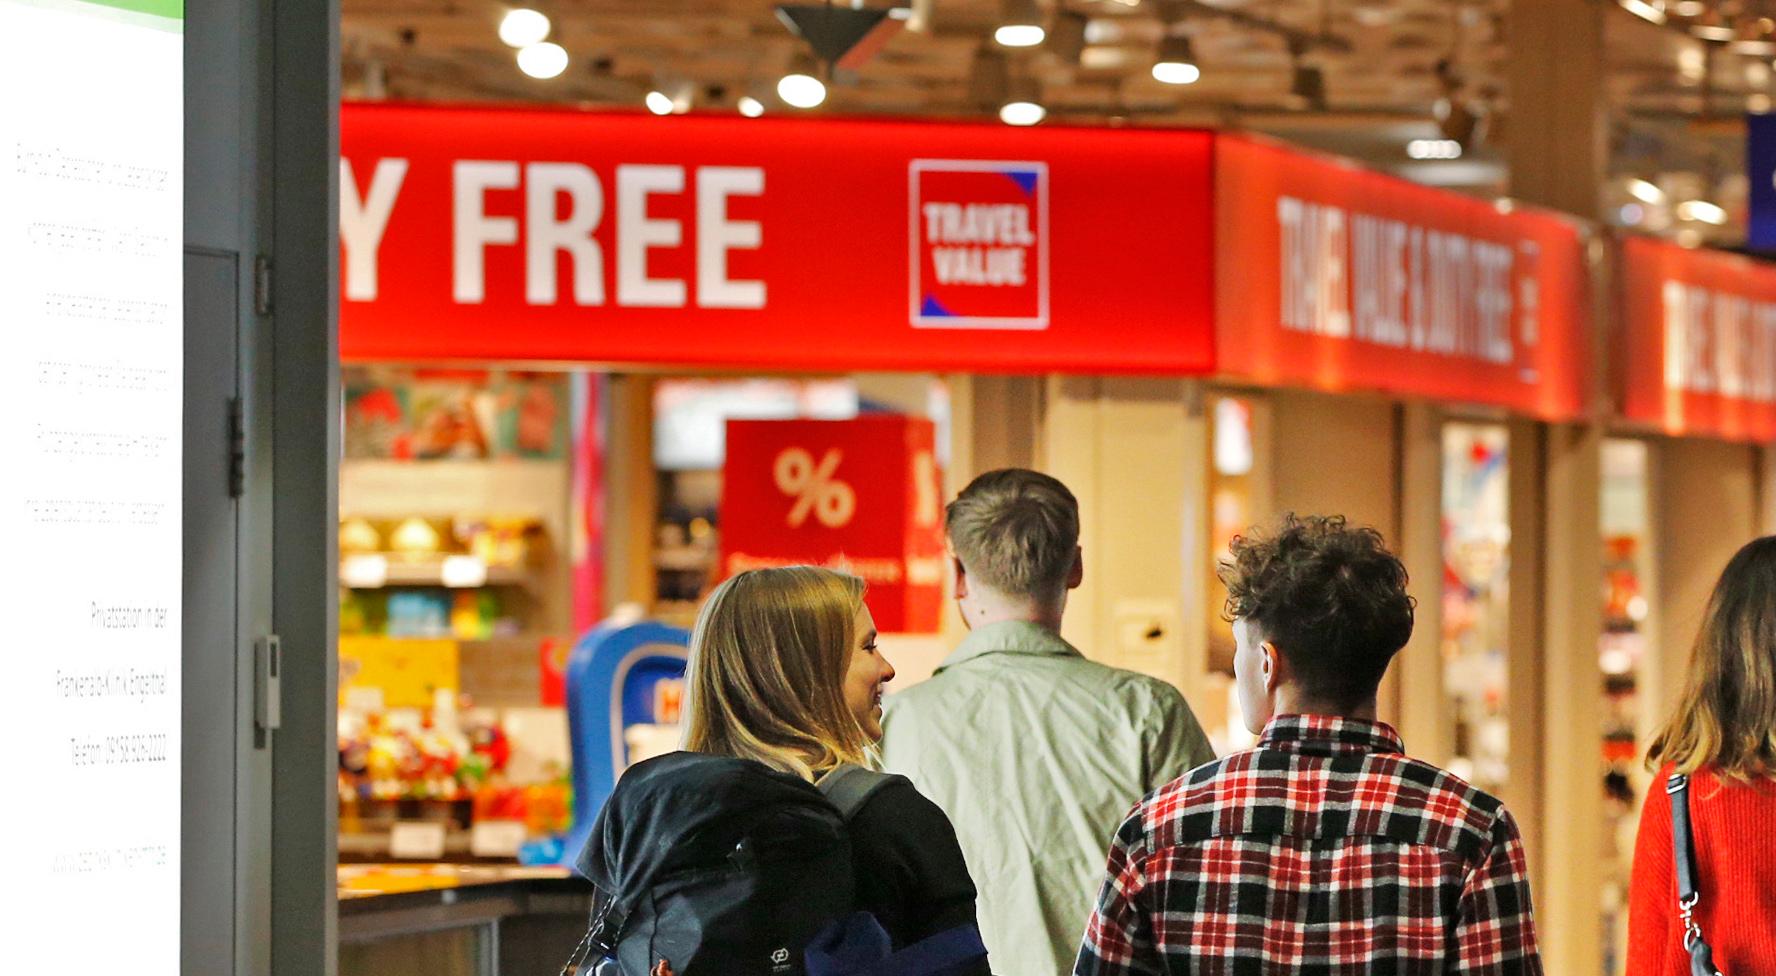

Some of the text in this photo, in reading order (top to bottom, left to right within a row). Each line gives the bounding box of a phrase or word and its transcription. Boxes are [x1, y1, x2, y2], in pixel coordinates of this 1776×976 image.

[453, 160, 767, 309] FREE
[923, 202, 1036, 246] TRAVEL
[932, 247, 1027, 287] VALUE
[770, 446, 857, 529] %
